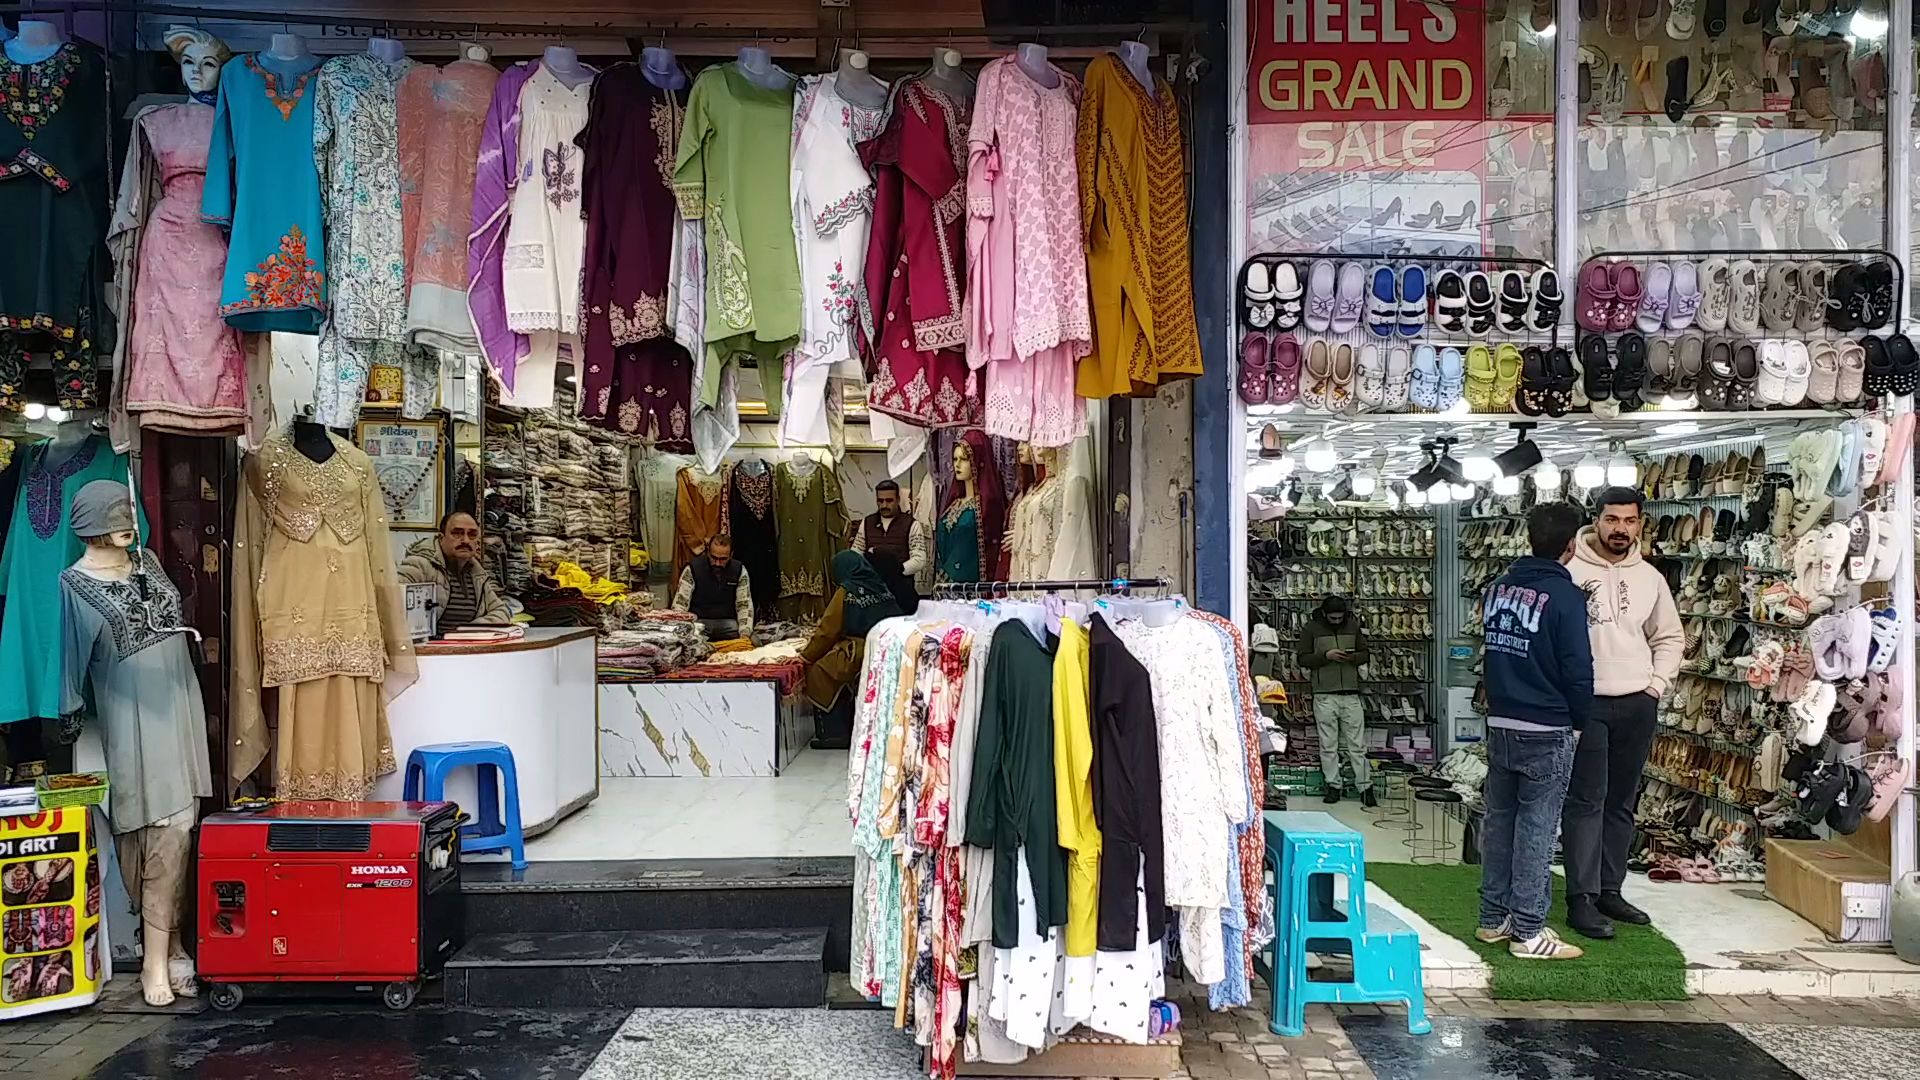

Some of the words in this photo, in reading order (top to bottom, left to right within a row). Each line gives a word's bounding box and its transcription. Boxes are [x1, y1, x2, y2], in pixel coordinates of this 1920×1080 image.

[1274, 0, 1457, 43] HEELS
[1259, 59, 1473, 110] GRAND
[1297, 121, 1436, 167] SALE
[1497, 633, 1530, 651] DISTRICT
[19, 836, 58, 855] ART
[351, 865, 408, 875] HONDA
[374, 878, 413, 888] 1200
